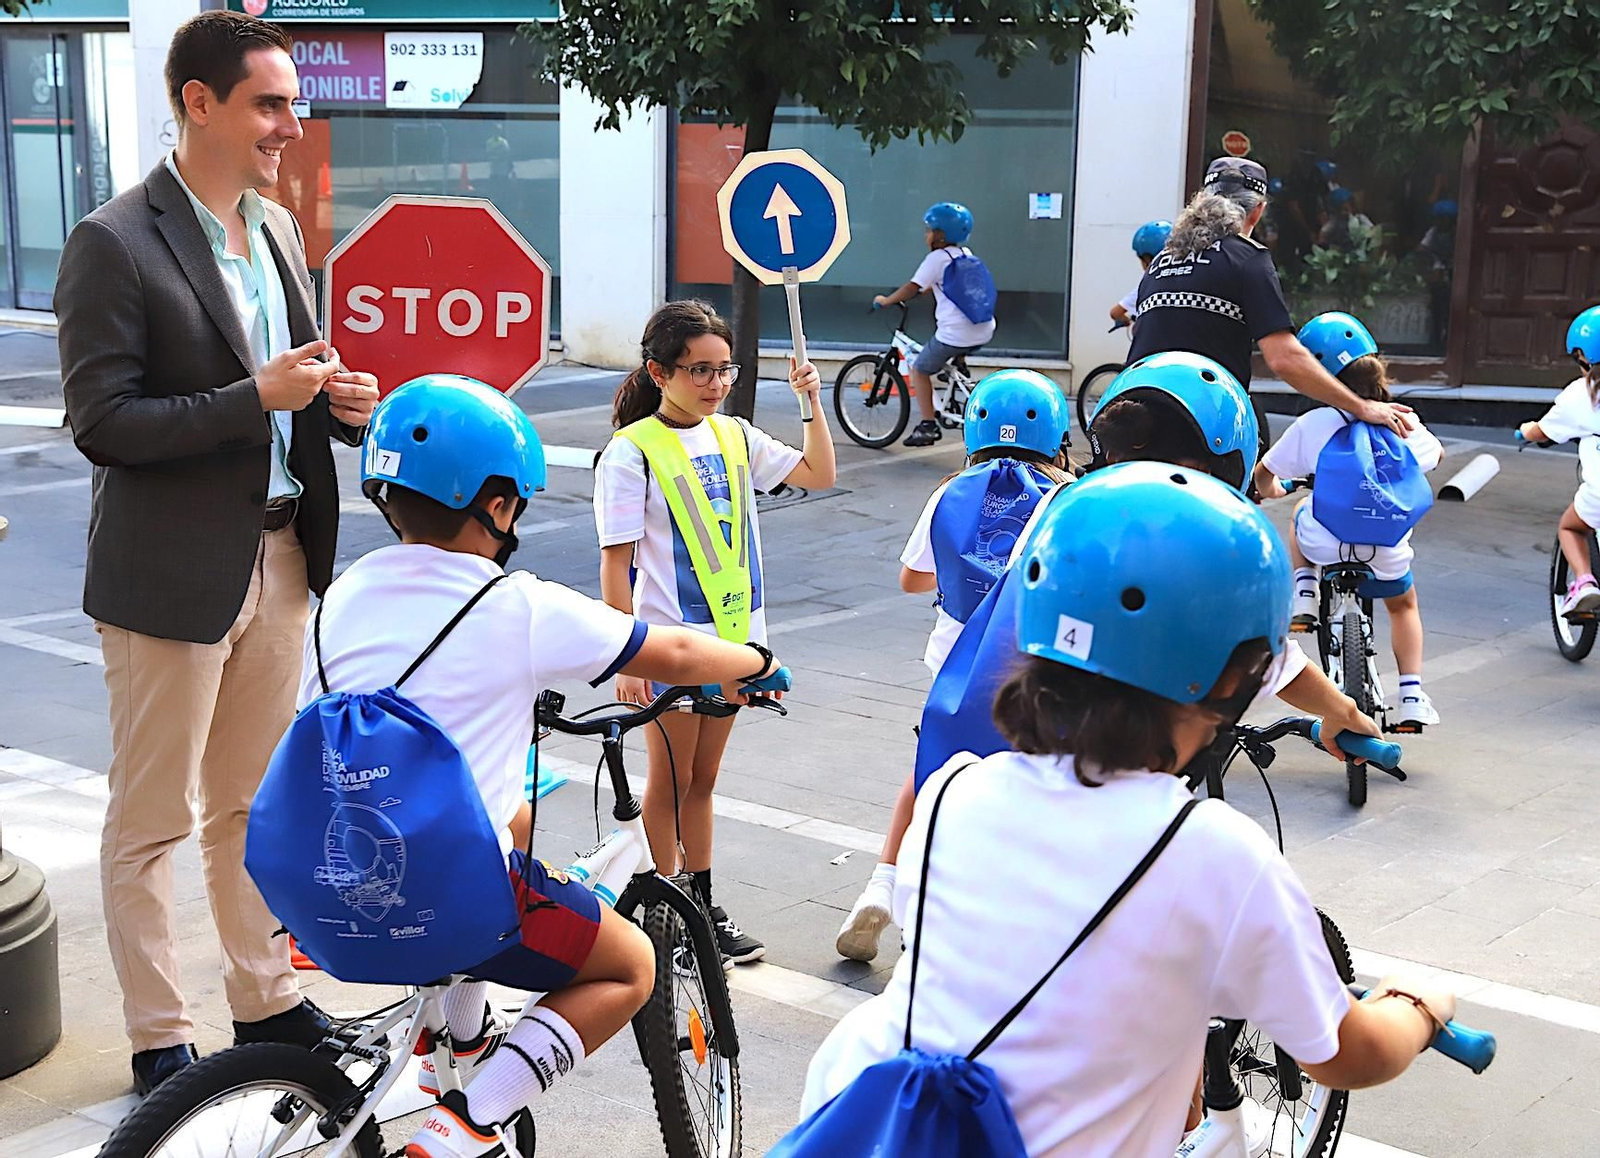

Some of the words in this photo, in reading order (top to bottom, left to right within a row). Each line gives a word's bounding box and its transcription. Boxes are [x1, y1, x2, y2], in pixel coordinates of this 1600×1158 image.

[320, 8, 330, 16] DE
[331, 7, 365, 16] SEGUROS
[293, 41, 350, 65] OCAL
[390, 43, 417, 56] 902
[421, 44, 447, 56] 333
[452, 44, 478, 56] 131
[300, 76, 381, 100] ONIBLE
[430, 87, 471, 103] Solvi
[1155, 265, 1193, 280] JEREZ
[342, 285, 532, 338] STOP
[1001, 427, 1015, 439] 20
[382, 454, 391, 470] 7
[731, 591, 745, 602] DGT
[1063, 627, 1077, 649] 4
[334, 766, 390, 785] OVILIDAD
